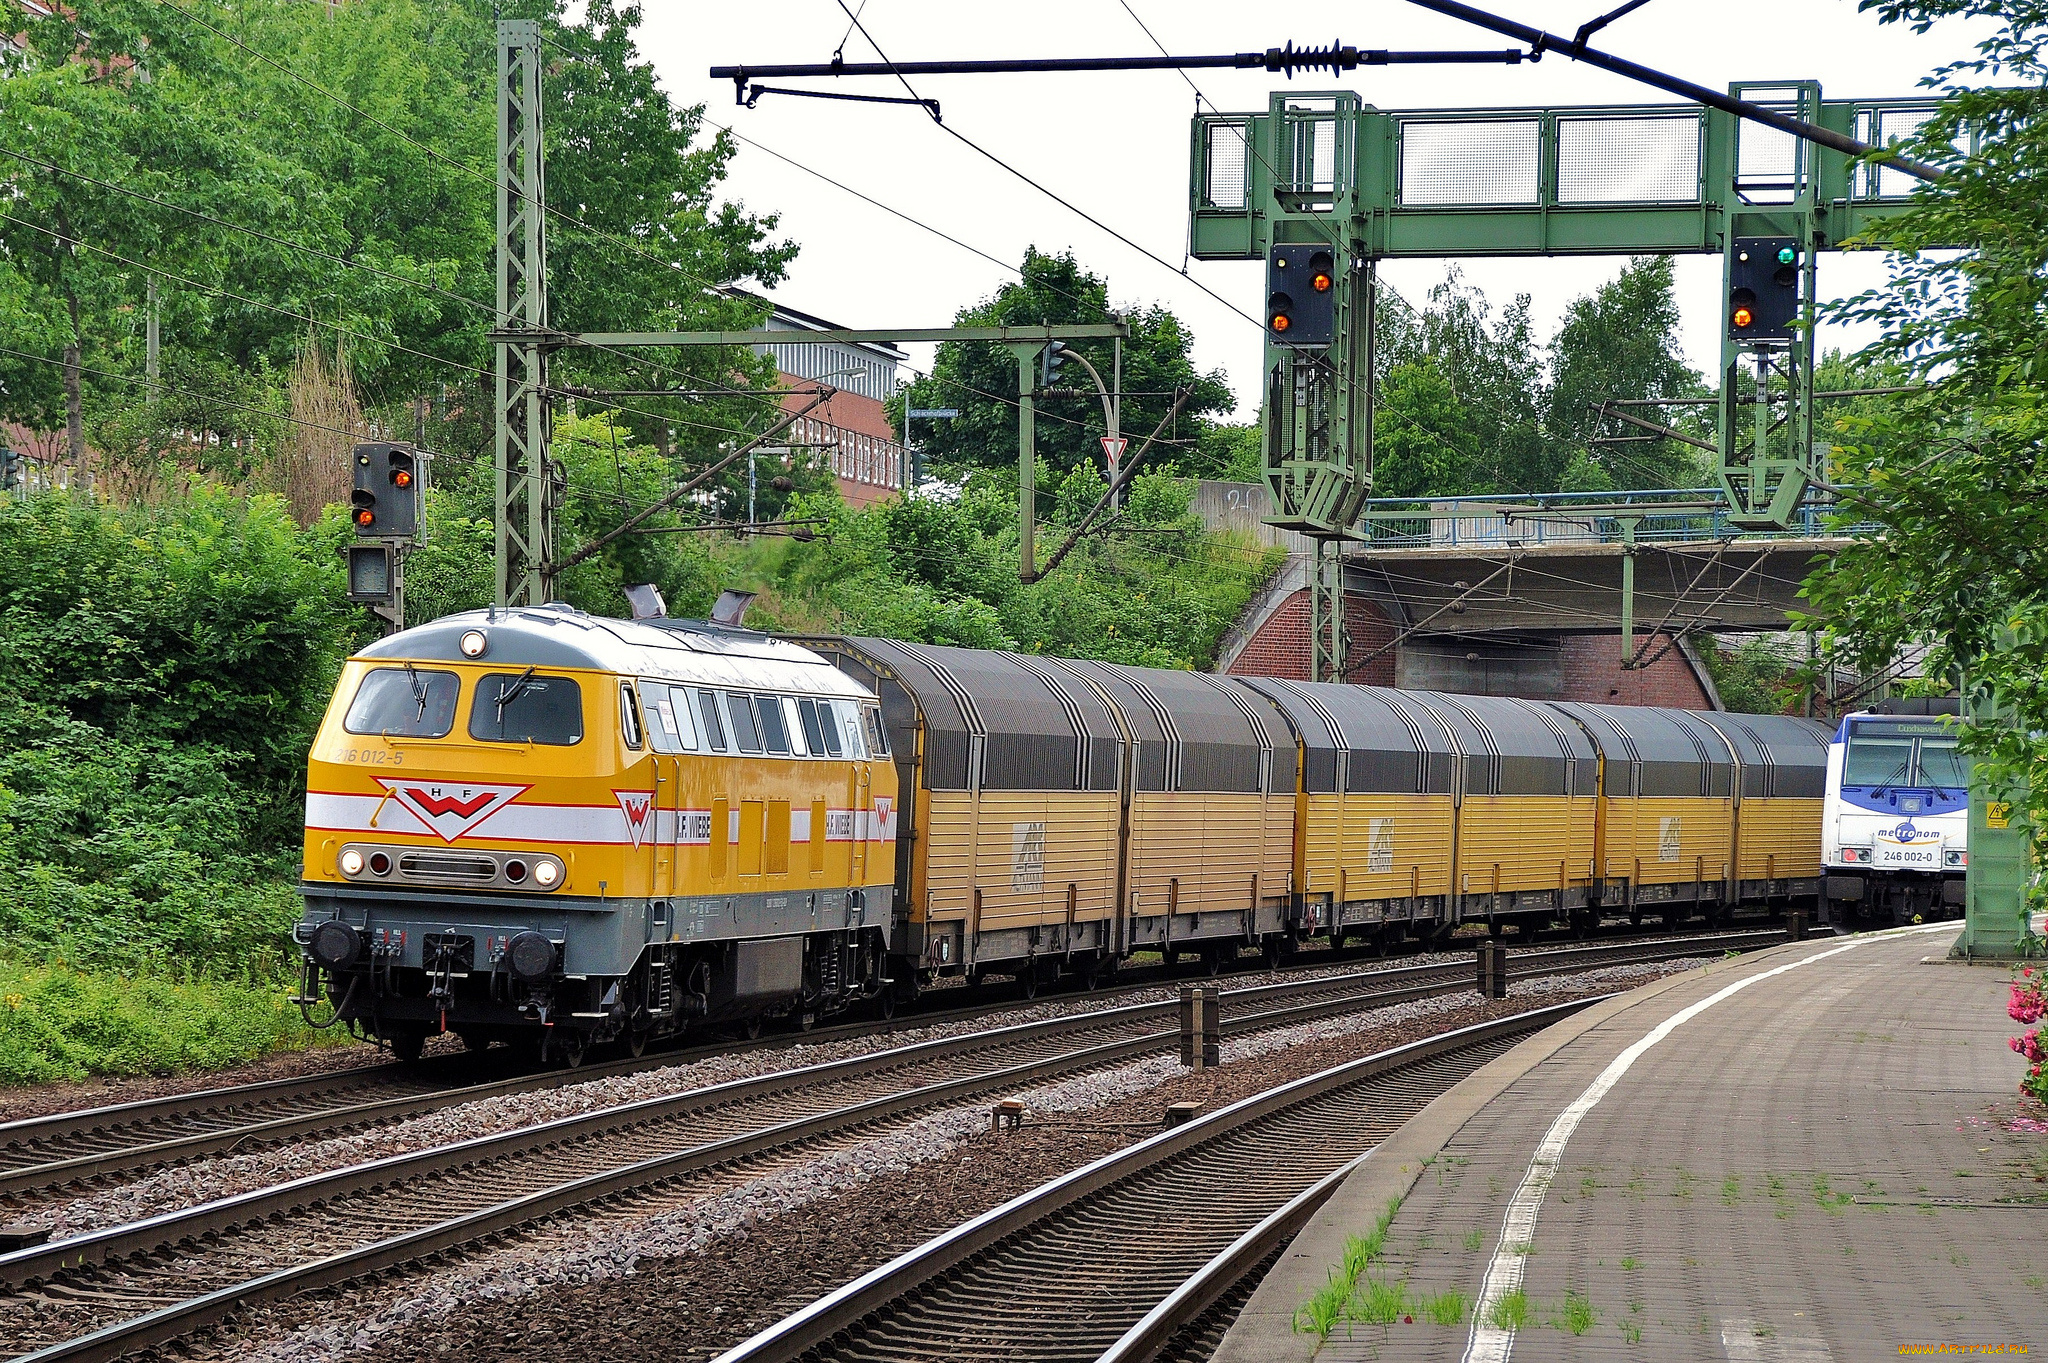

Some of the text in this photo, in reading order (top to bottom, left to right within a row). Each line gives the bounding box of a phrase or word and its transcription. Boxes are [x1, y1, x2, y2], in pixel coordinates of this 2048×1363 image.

[1898, 724, 1941, 733] Cuxhaven
[334, 748, 404, 765] 216 012-5
[431, 787, 472, 798] H F
[689, 815, 711, 838] WIEBE
[1878, 828, 1940, 839] metronom
[1884, 851, 1933, 862] 246 002-0
